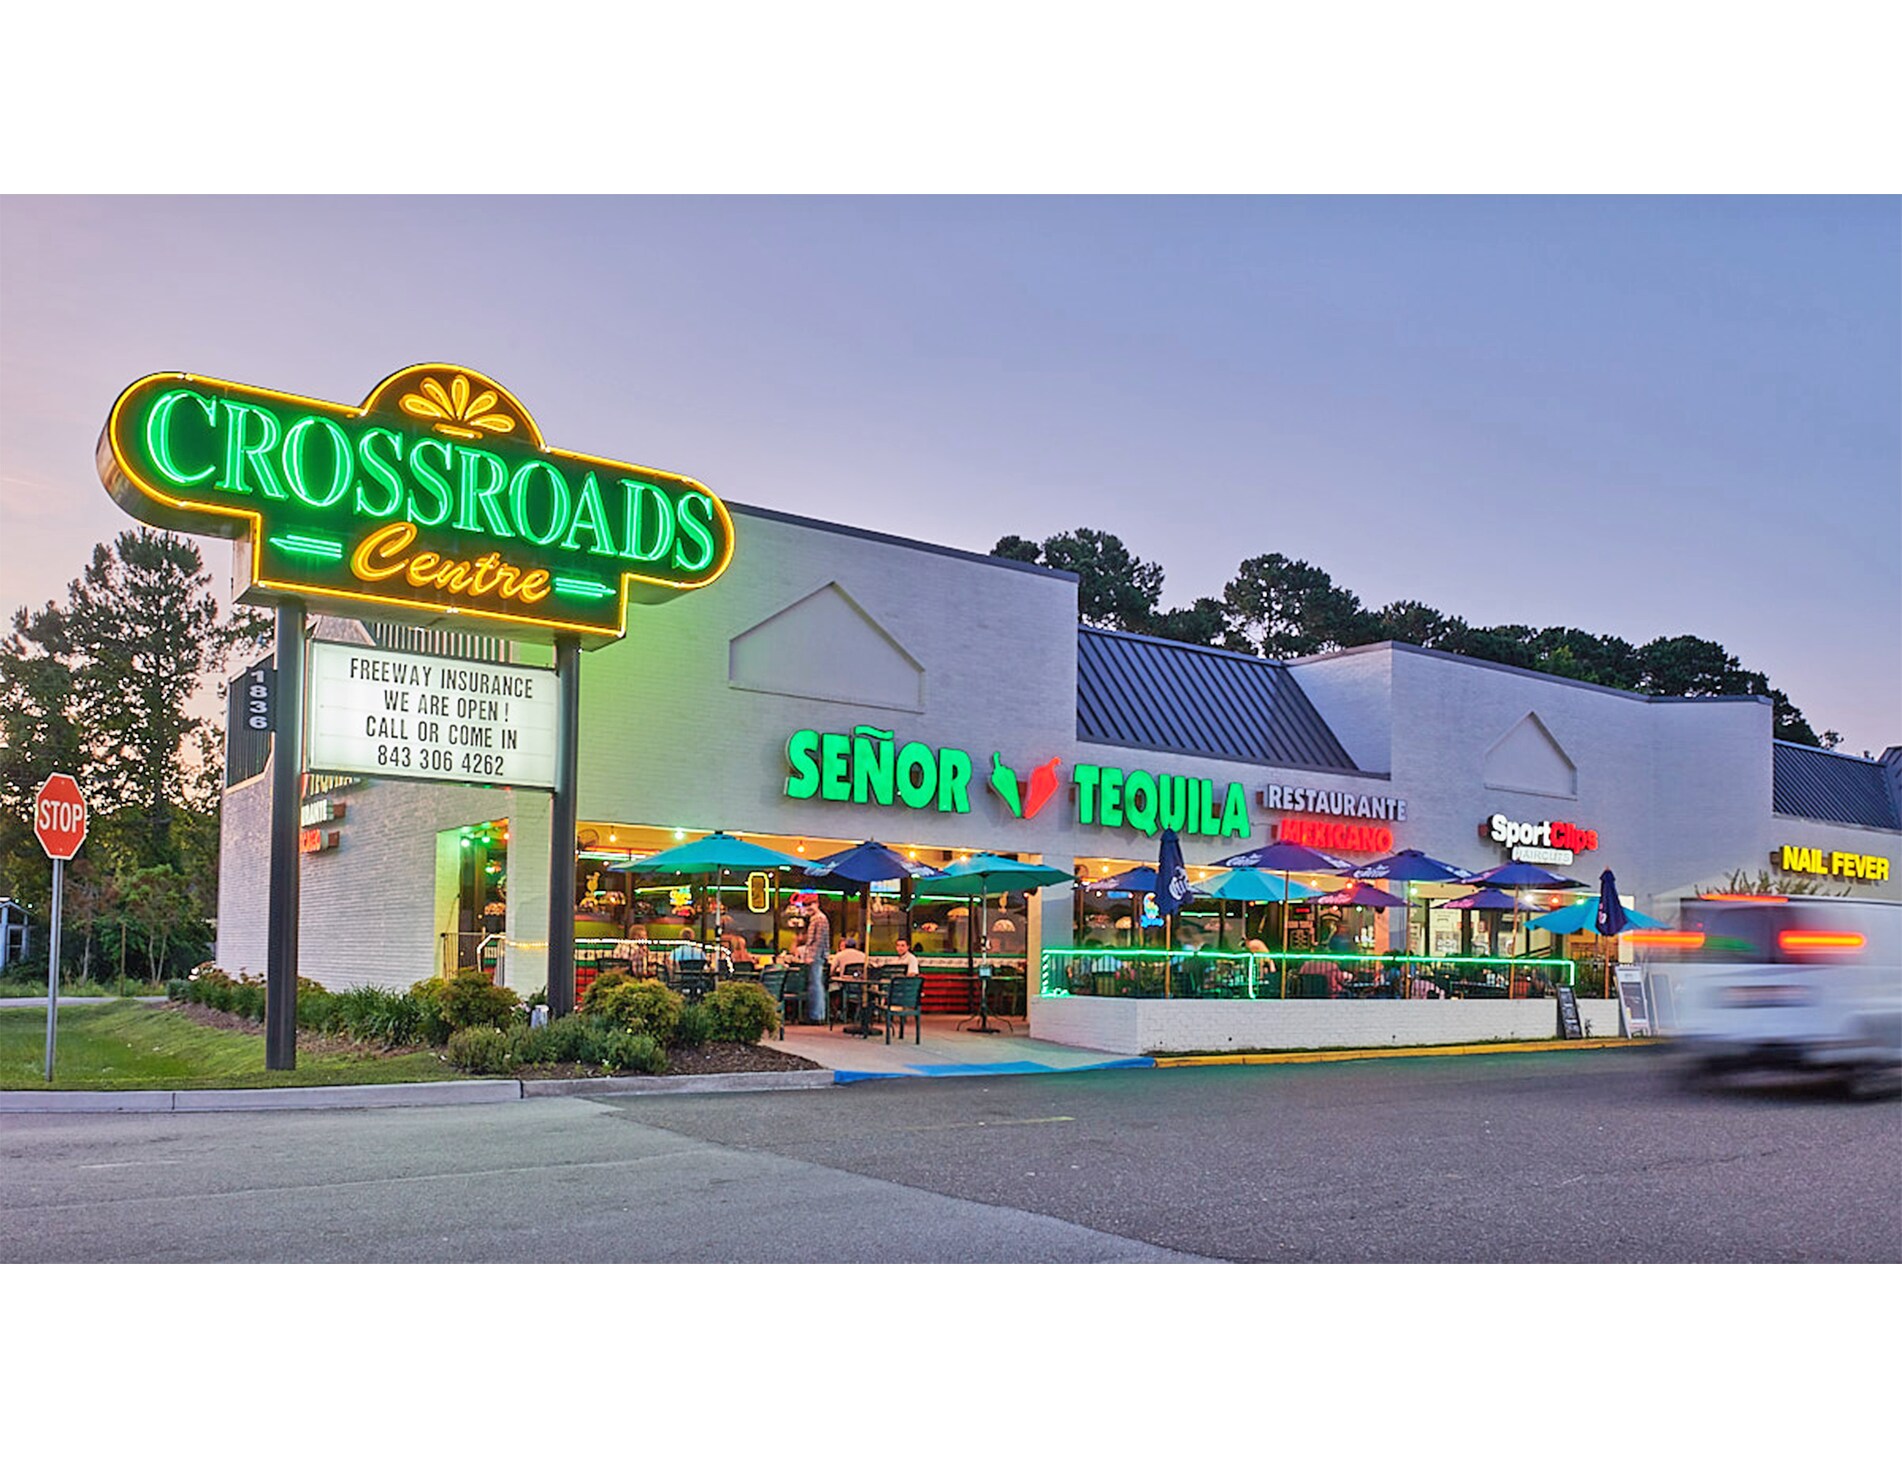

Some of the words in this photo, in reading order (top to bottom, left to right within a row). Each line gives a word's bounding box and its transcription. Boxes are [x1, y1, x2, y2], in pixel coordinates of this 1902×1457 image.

[144, 389, 716, 574] CROSSROADS
[350, 521, 553, 602] Centre
[350, 657, 432, 687] FREEWAY
[440, 668, 533, 699] INSURANCE
[384, 689, 410, 712] WE
[417, 694, 449, 717] ARE
[366, 715, 408, 740] CALL
[418, 721, 439, 743] OR
[449, 724, 492, 748] COME
[501, 729, 518, 749] IN
[378, 745, 412, 768] 843
[419, 748, 453, 771] 306
[461, 753, 504, 776] 4262
[786, 725, 972, 814] SEÑOR
[1073, 764, 1251, 838] TEQUILA
[39, 799, 83, 833] STOP
[1268, 784, 1408, 822] RESTAURANTE
[1280, 818, 1394, 853] MEXICANO
[1782, 844, 1829, 875] NAIL
[1831, 850, 1890, 881] FEVER
